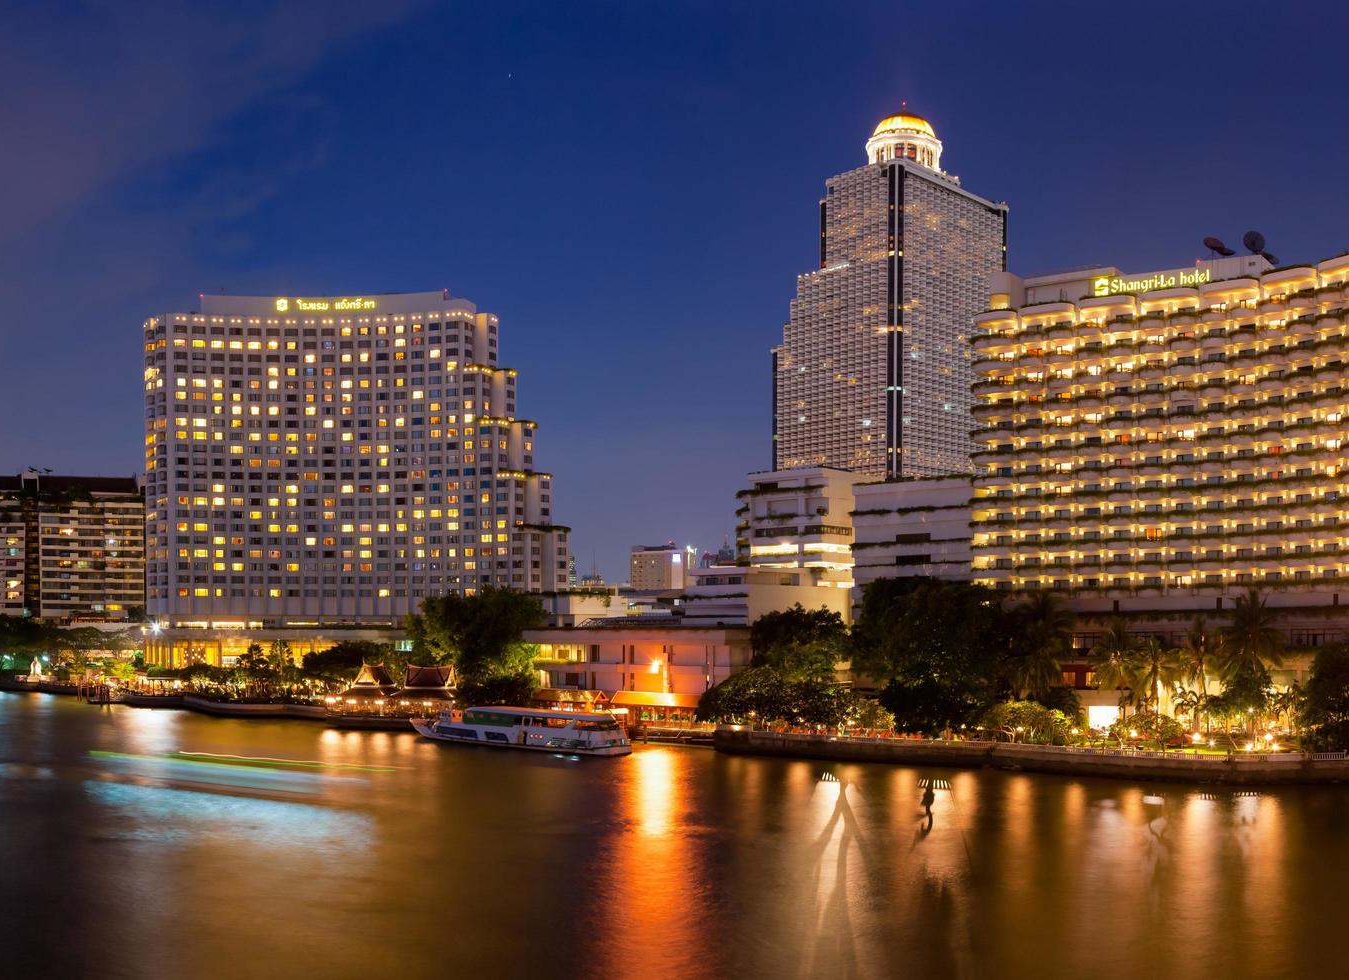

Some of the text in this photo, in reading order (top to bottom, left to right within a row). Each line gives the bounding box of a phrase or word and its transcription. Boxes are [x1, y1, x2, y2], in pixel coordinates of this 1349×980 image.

[1110, 269, 1210, 293] Shangri-La hotel
[296, 298, 329, 310] โรงแรม
